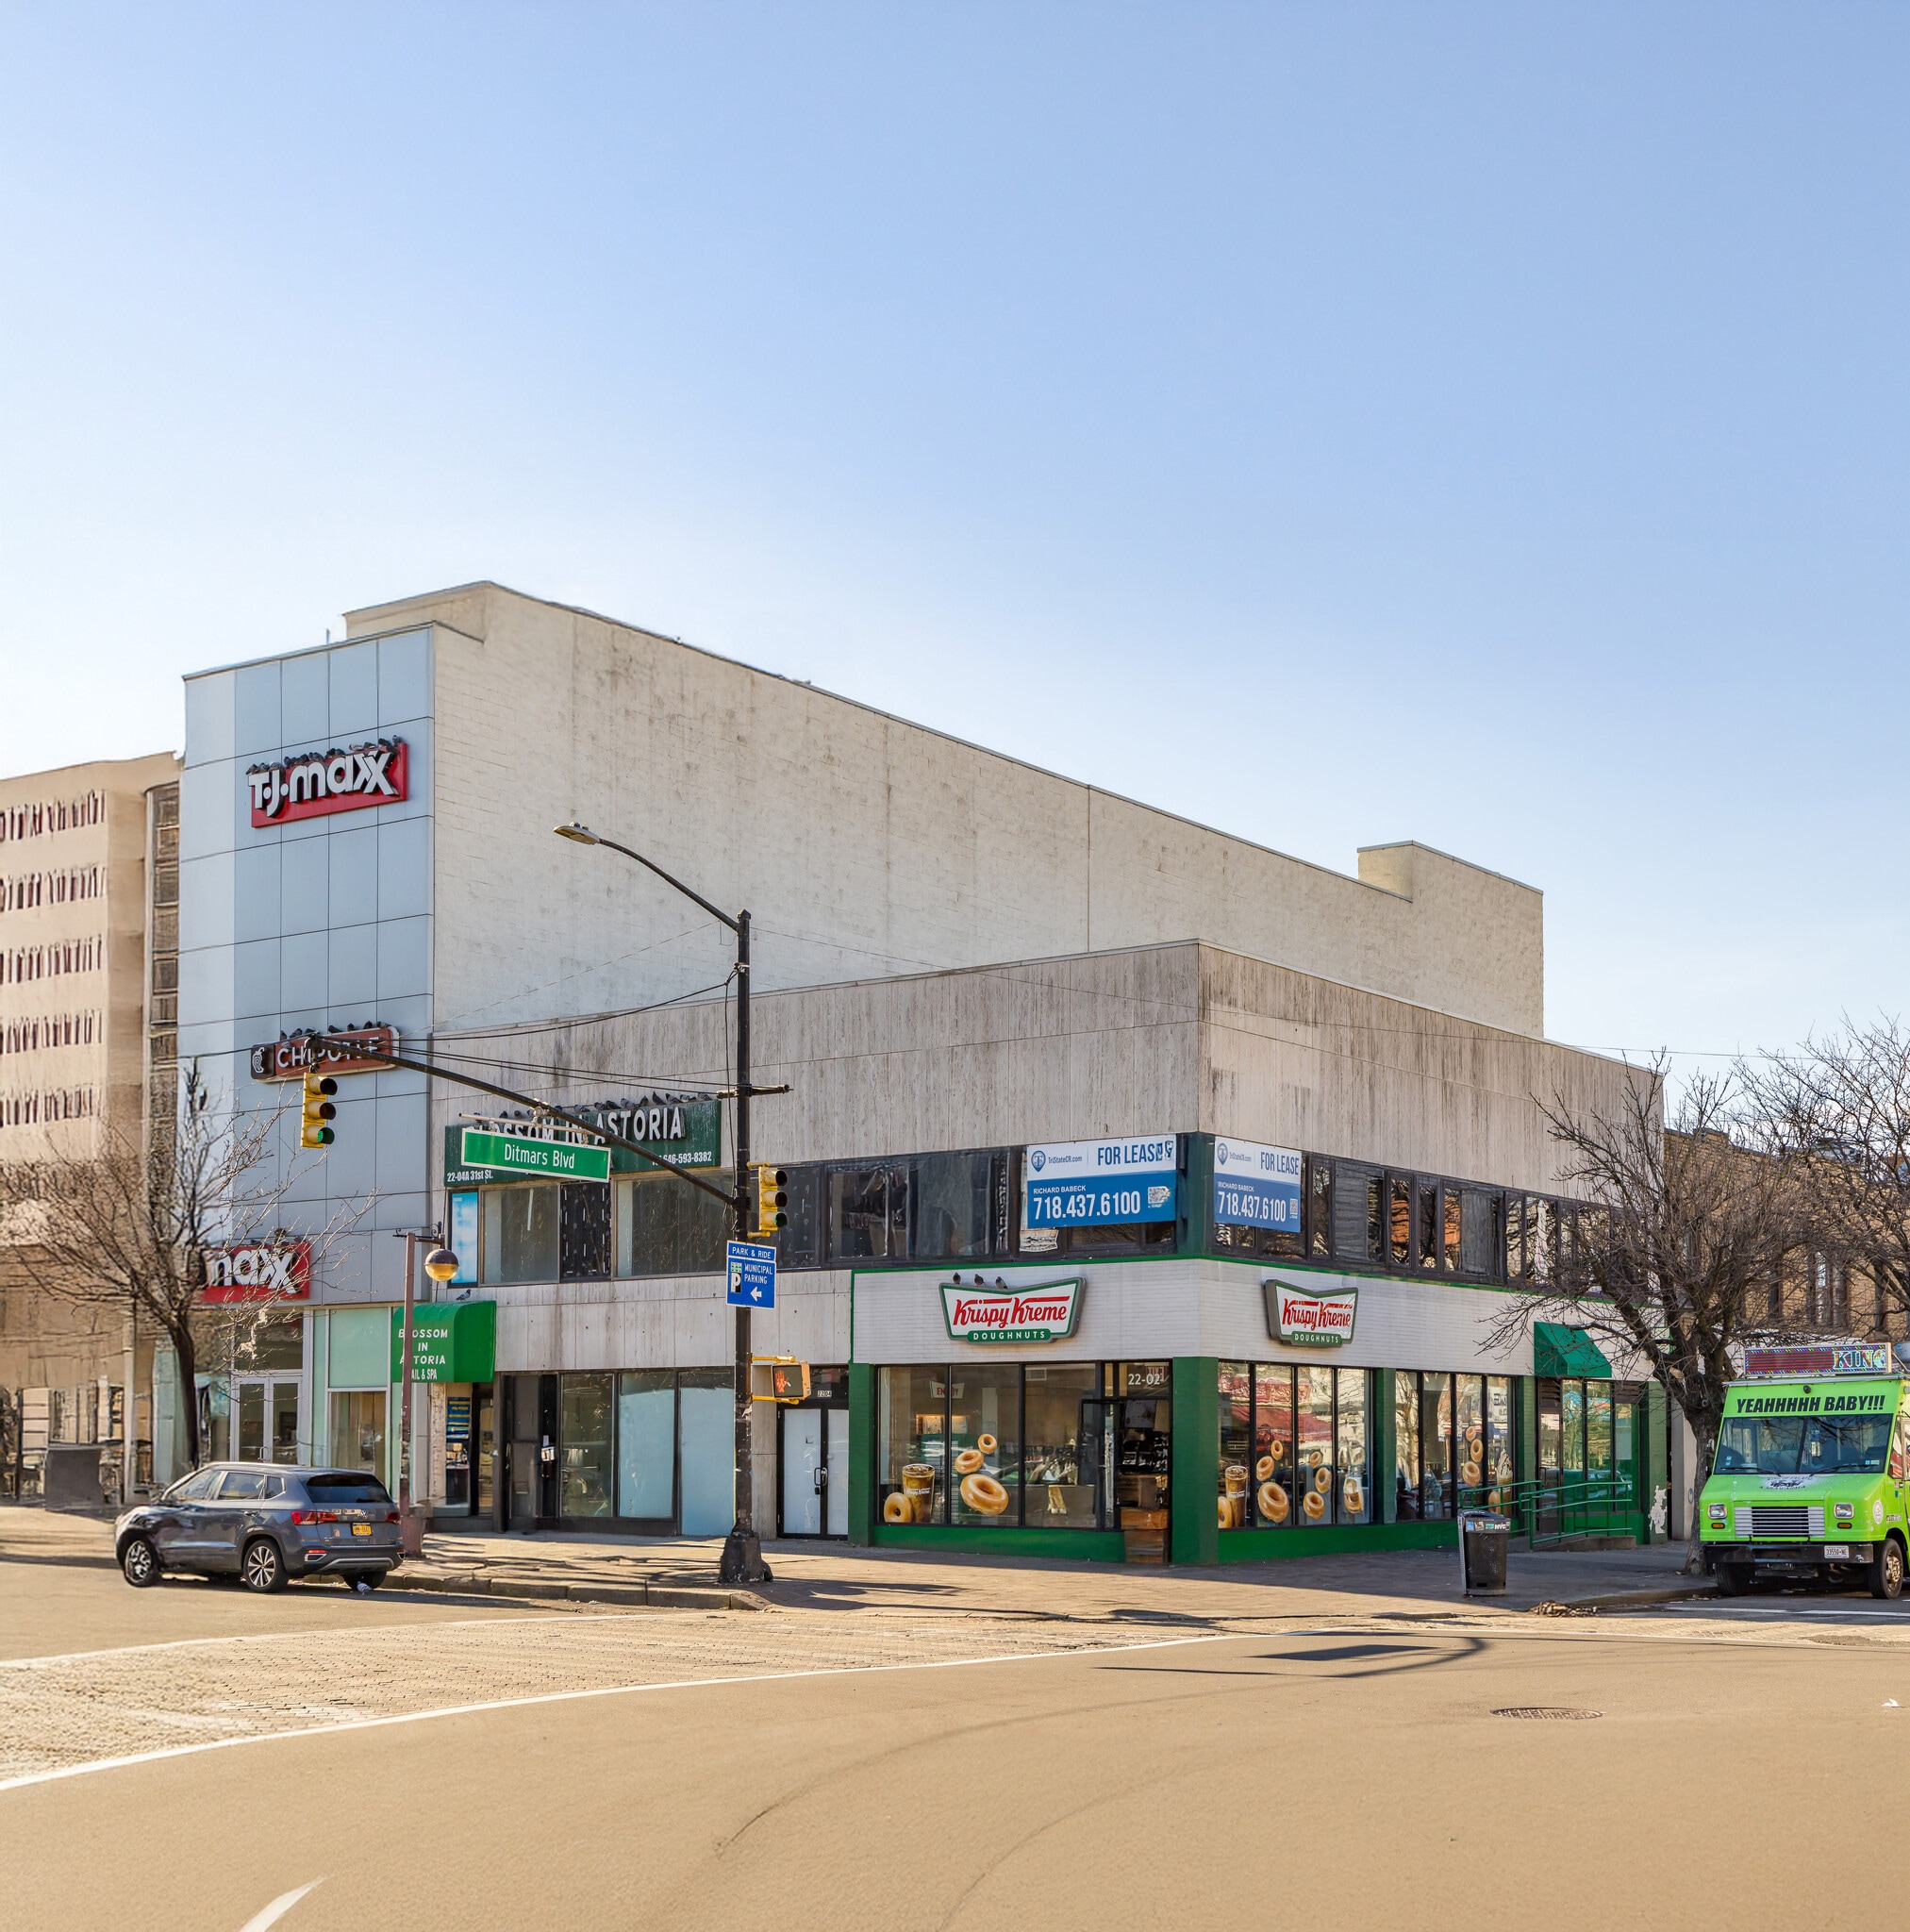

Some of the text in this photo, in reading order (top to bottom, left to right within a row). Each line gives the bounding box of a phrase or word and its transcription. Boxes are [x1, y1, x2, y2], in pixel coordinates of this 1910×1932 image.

[594, 1106, 683, 1146] ASTORIA
[504, 1143, 575, 1170] Ditmars Blvd
[663, 1151, 712, 1164] 646-593-8382
[1048, 1155, 1083, 1164] TriStateCR.com
[1097, 1146, 1121, 1166] FOR
[1260, 1151, 1300, 1175] FOR LEASE
[447, 1172, 470, 1182] 22-04A
[471, 1170, 484, 1181] 31st
[1060, 1185, 1087, 1193] BABECK
[1218, 1181, 1254, 1192] RICHARD BABECK
[1033, 1191, 1141, 1220] 718.437.6100
[1218, 1191, 1287, 1223] 718.437.6100
[732, 1246, 772, 1259] PARK & RIDE
[744, 1263, 772, 1275] MUNICIPAL
[743, 1274, 768, 1284] PARKING
[953, 1295, 1071, 1329] Krispy Kreme
[1282, 1298, 1353, 1331] Krispy Kreme
[398, 1328, 448, 1339] BOSSOM
[972, 1330, 1045, 1341] DOUGHNUTS
[1294, 1333, 1338, 1343] DOUGHNUTS
[418, 1341, 428, 1352] IN
[399, 1355, 446, 1365] ATORIA
[411, 1369, 438, 1380] AIL & SPA
[1128, 1374, 1161, 1386] 22-02
[937, 1387, 959, 1396] ENY
[1736, 1395, 1885, 1413] YEAHHHHH BABY!!!
